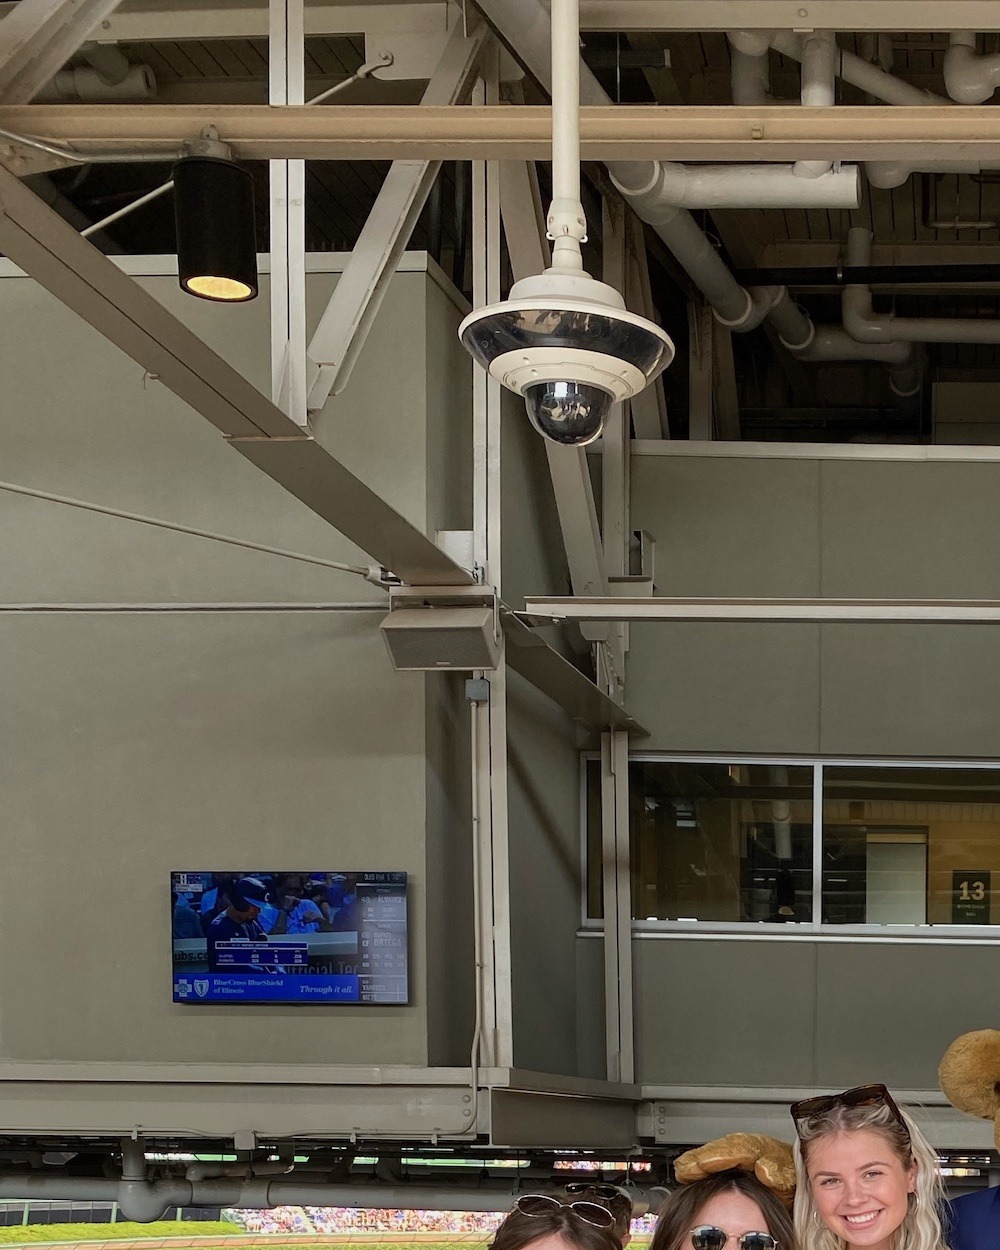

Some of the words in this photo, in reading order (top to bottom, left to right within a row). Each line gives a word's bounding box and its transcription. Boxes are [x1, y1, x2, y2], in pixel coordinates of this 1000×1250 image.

[959, 881, 986, 900] 13
[299, 985, 333, 994] Through
[334, 985, 341, 993] it
[341, 985, 353, 993] all.
